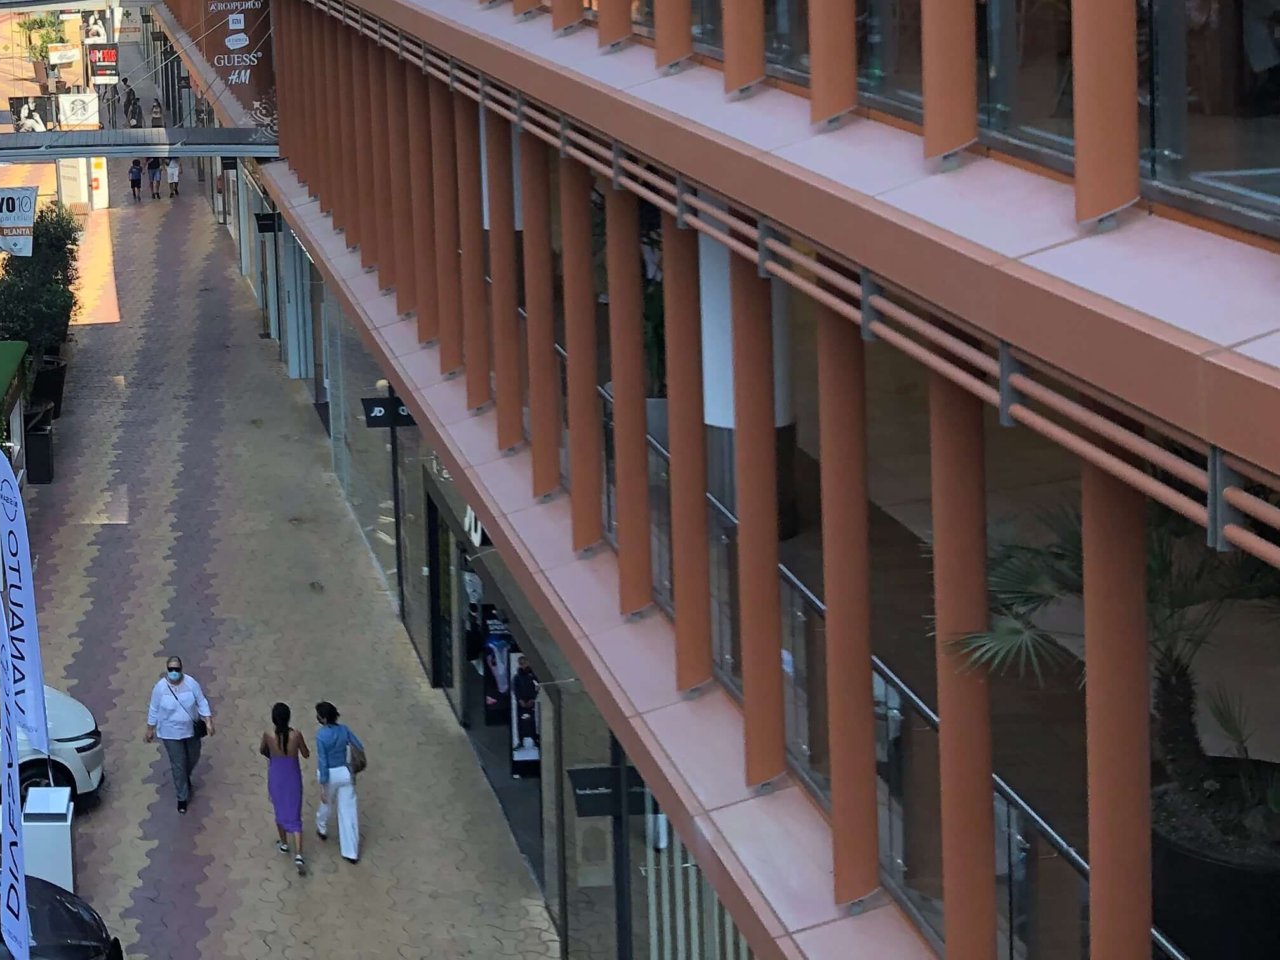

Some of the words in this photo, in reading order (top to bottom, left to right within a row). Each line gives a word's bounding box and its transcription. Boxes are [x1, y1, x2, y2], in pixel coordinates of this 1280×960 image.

[214, 53, 258, 67] GUESS
[228, 68, 251, 85] H&M
[370, 406, 385, 417] JD
